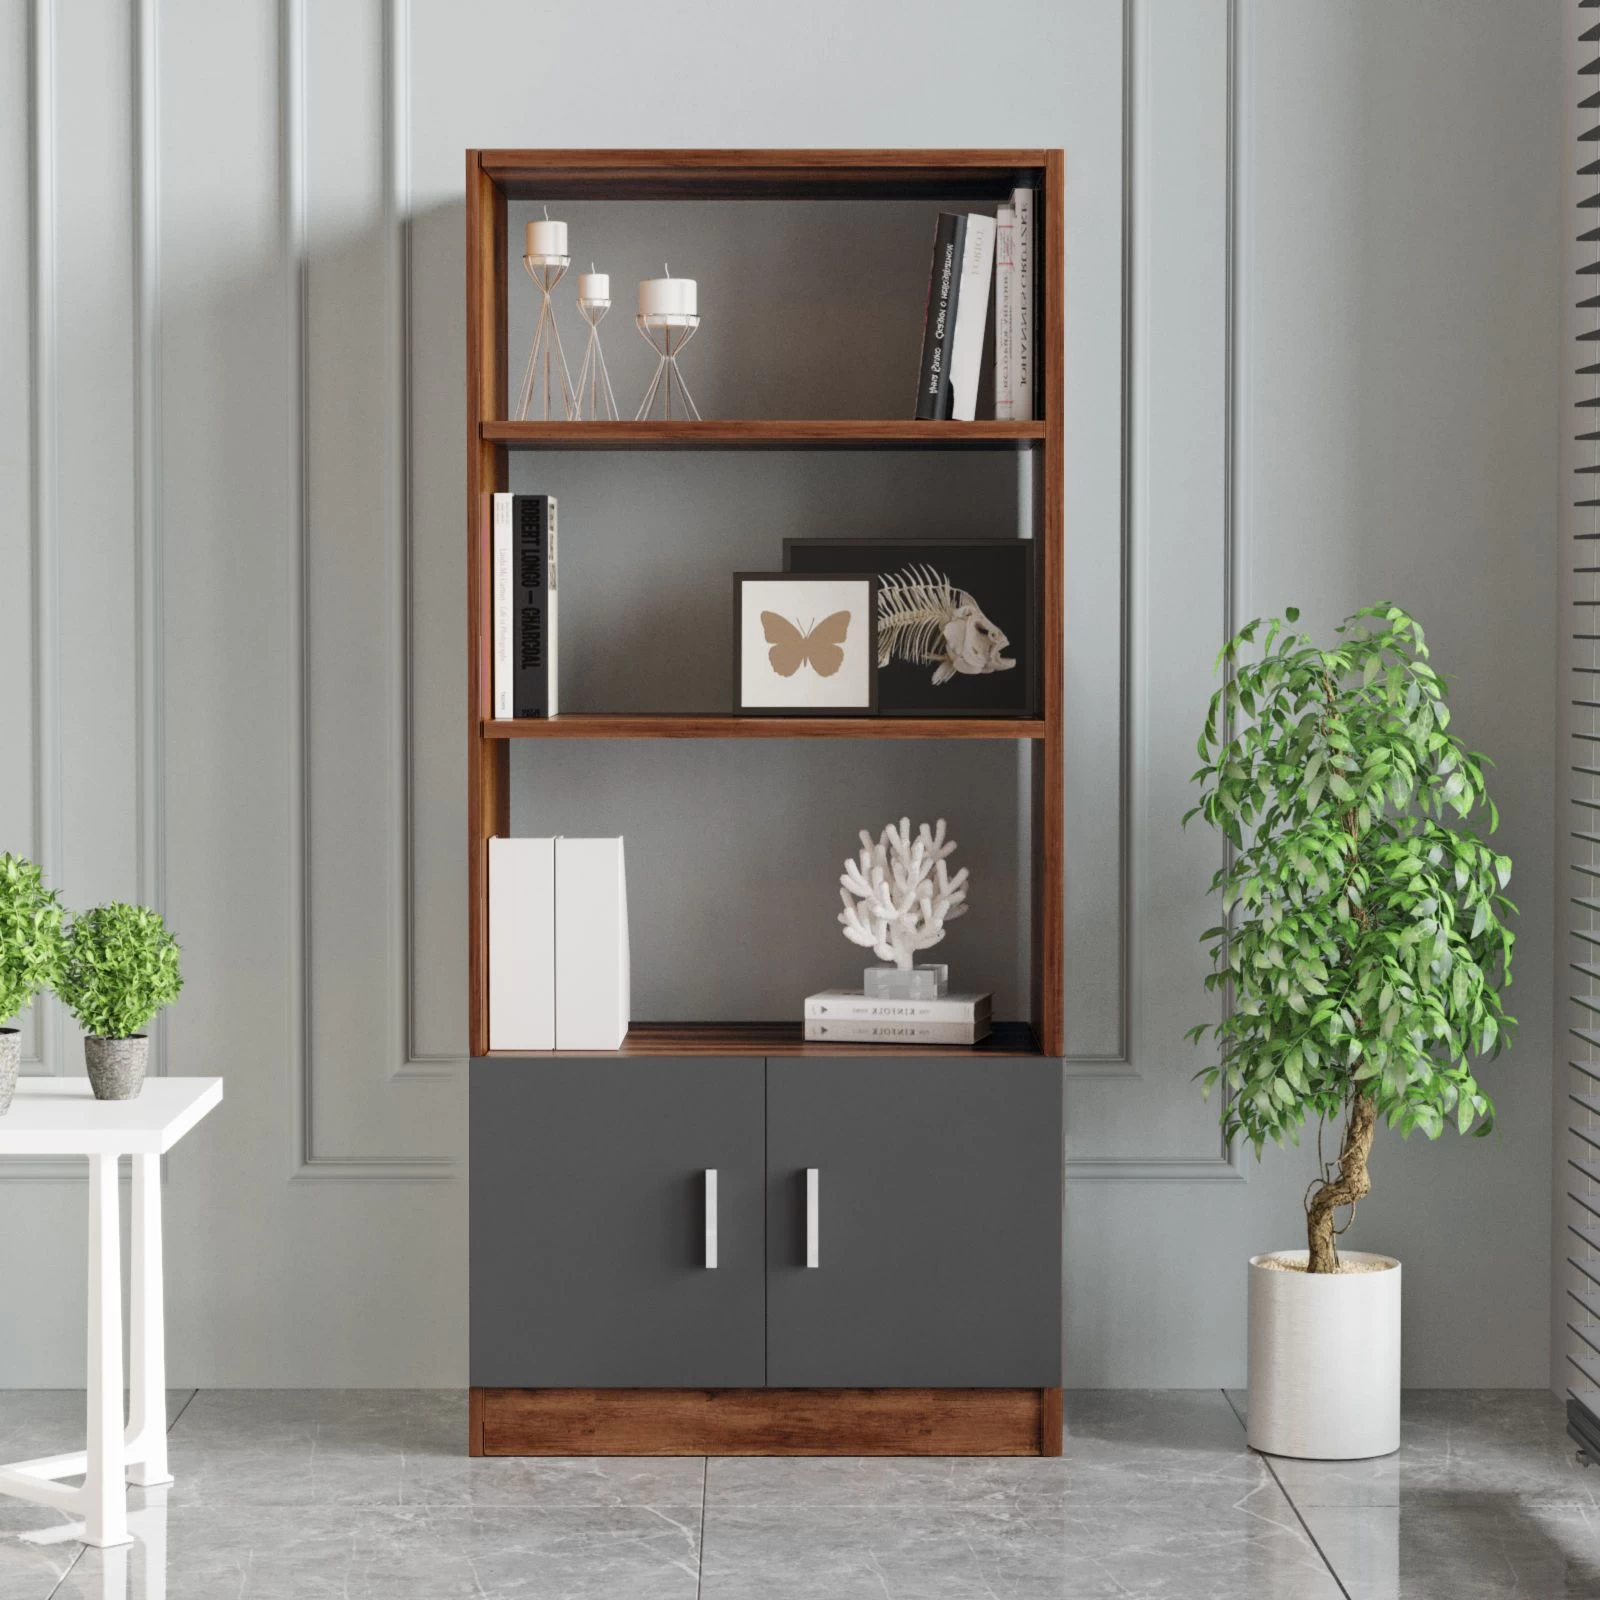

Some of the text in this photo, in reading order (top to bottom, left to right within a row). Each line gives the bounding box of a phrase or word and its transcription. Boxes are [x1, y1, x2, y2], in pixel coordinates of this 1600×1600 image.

[520, 499, 541, 546] ROBERT
[520, 549, 541, 588] LONGO
[520, 607, 541, 670] CHARCOAL
